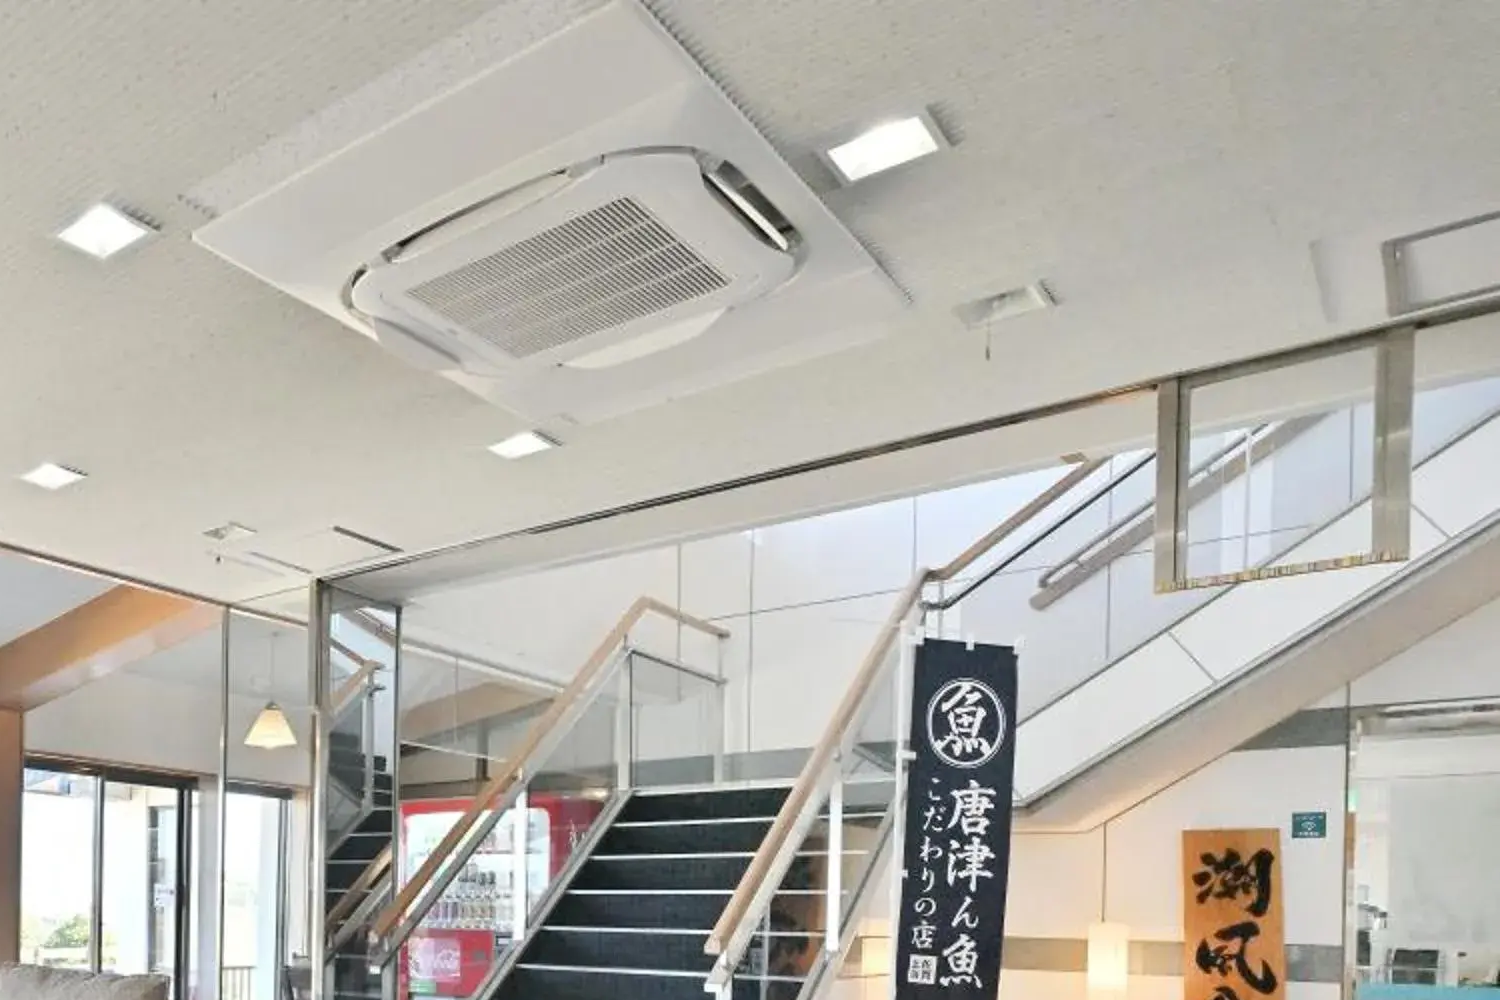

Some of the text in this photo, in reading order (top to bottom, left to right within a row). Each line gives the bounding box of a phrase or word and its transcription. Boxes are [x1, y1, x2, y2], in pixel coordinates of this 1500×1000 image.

[934, 682, 992, 757] 魚
[911, 777, 947, 949] こだわりの店
[940, 779, 997, 988] 唐津ん魚
